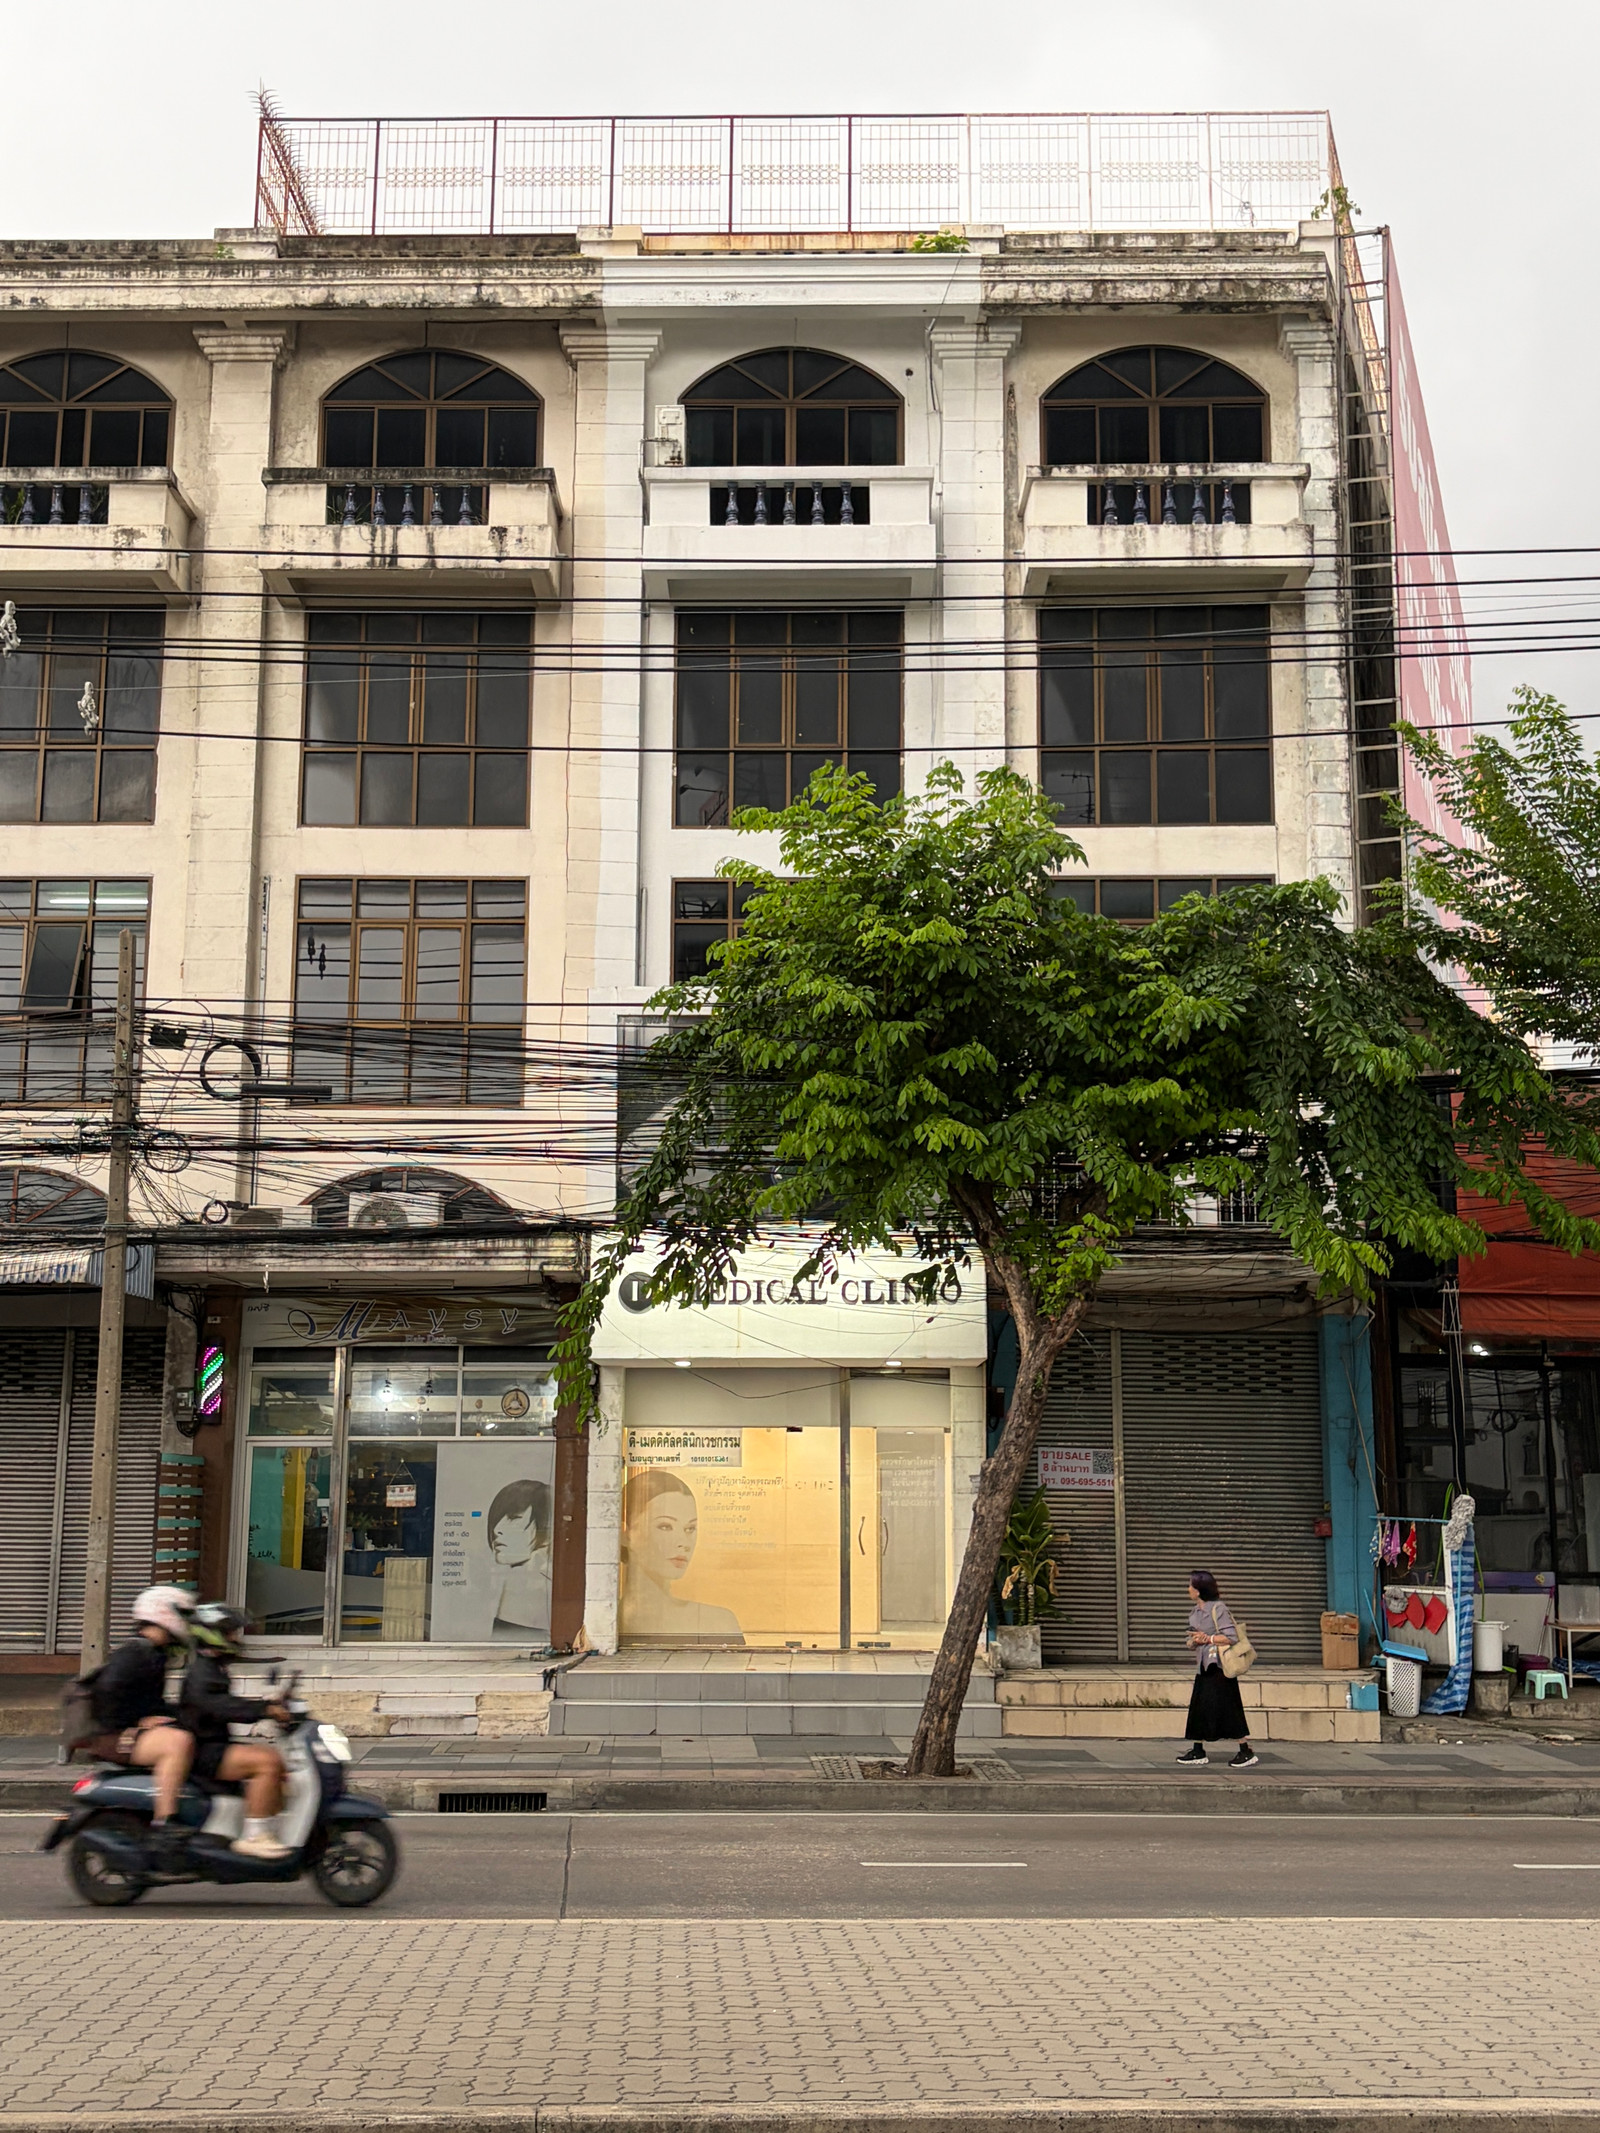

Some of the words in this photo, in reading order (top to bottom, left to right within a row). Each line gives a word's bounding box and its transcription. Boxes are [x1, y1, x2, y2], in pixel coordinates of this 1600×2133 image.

[1041, 1450, 1064, 1460] ขาย
[1065, 1451, 1091, 1461] SALE
[1043, 1463, 1049, 1472] 8
[1051, 1460, 1090, 1473] ล้านบาท
